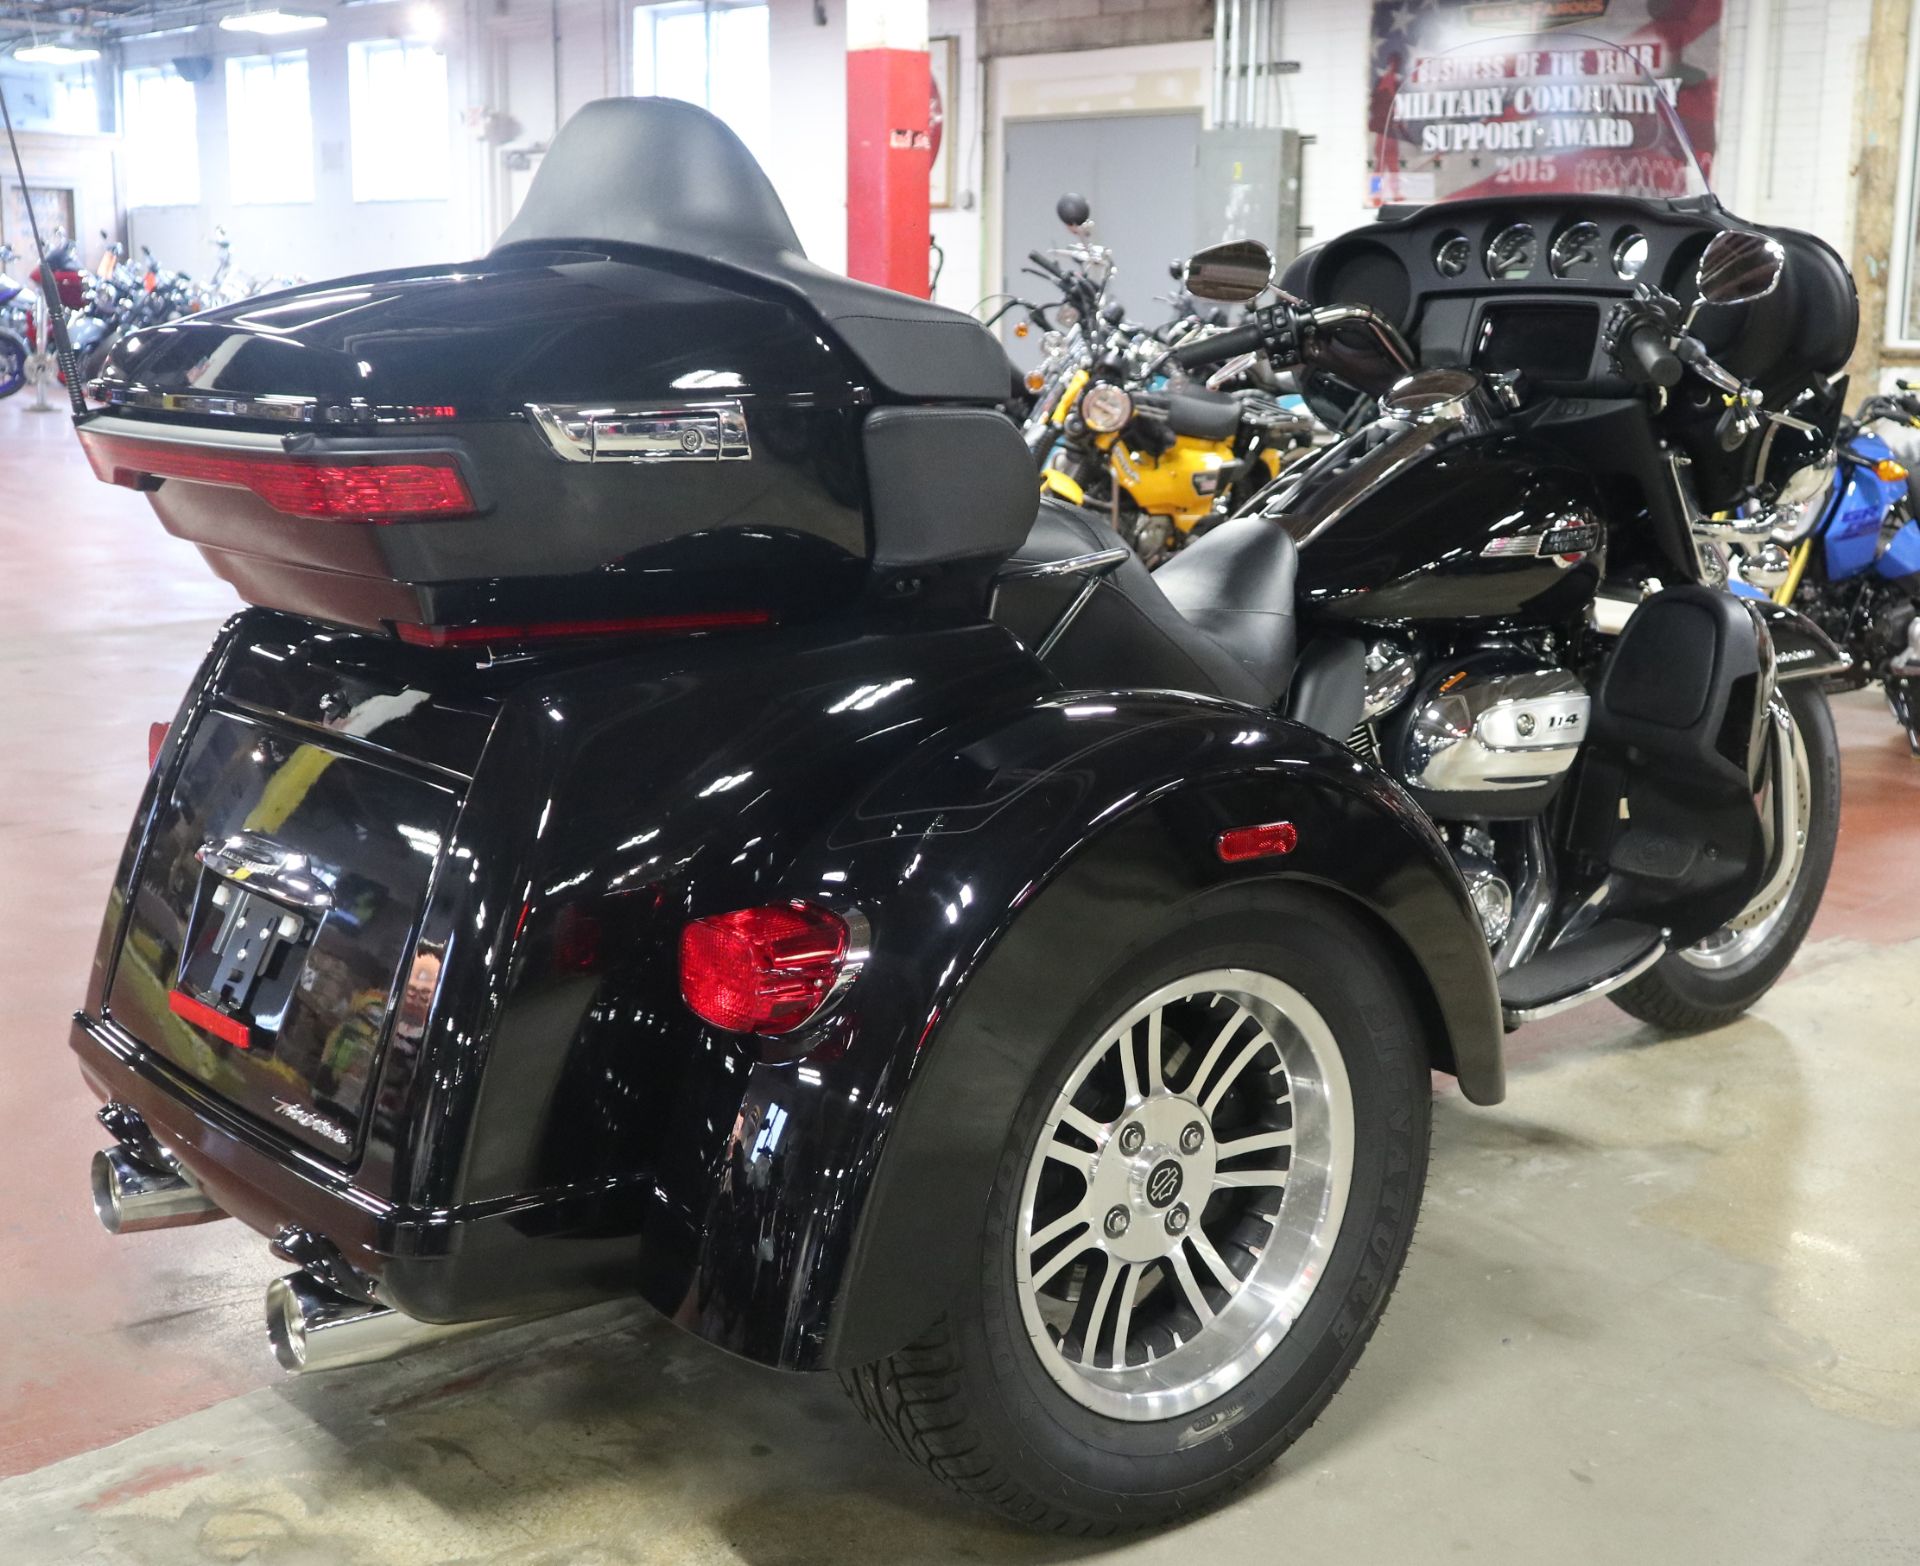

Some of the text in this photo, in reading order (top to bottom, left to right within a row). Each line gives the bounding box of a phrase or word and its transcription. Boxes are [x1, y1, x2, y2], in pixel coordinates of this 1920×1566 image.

[1418, 45, 1653, 83] BUSINESS OF THE YEAR
[1393, 79, 1681, 120] MILITARY COMMUNITY
[1422, 118, 1634, 151] SUPPORT AWARD
[1495, 156, 1556, 183] 2015
[1548, 713, 1579, 728] 114
